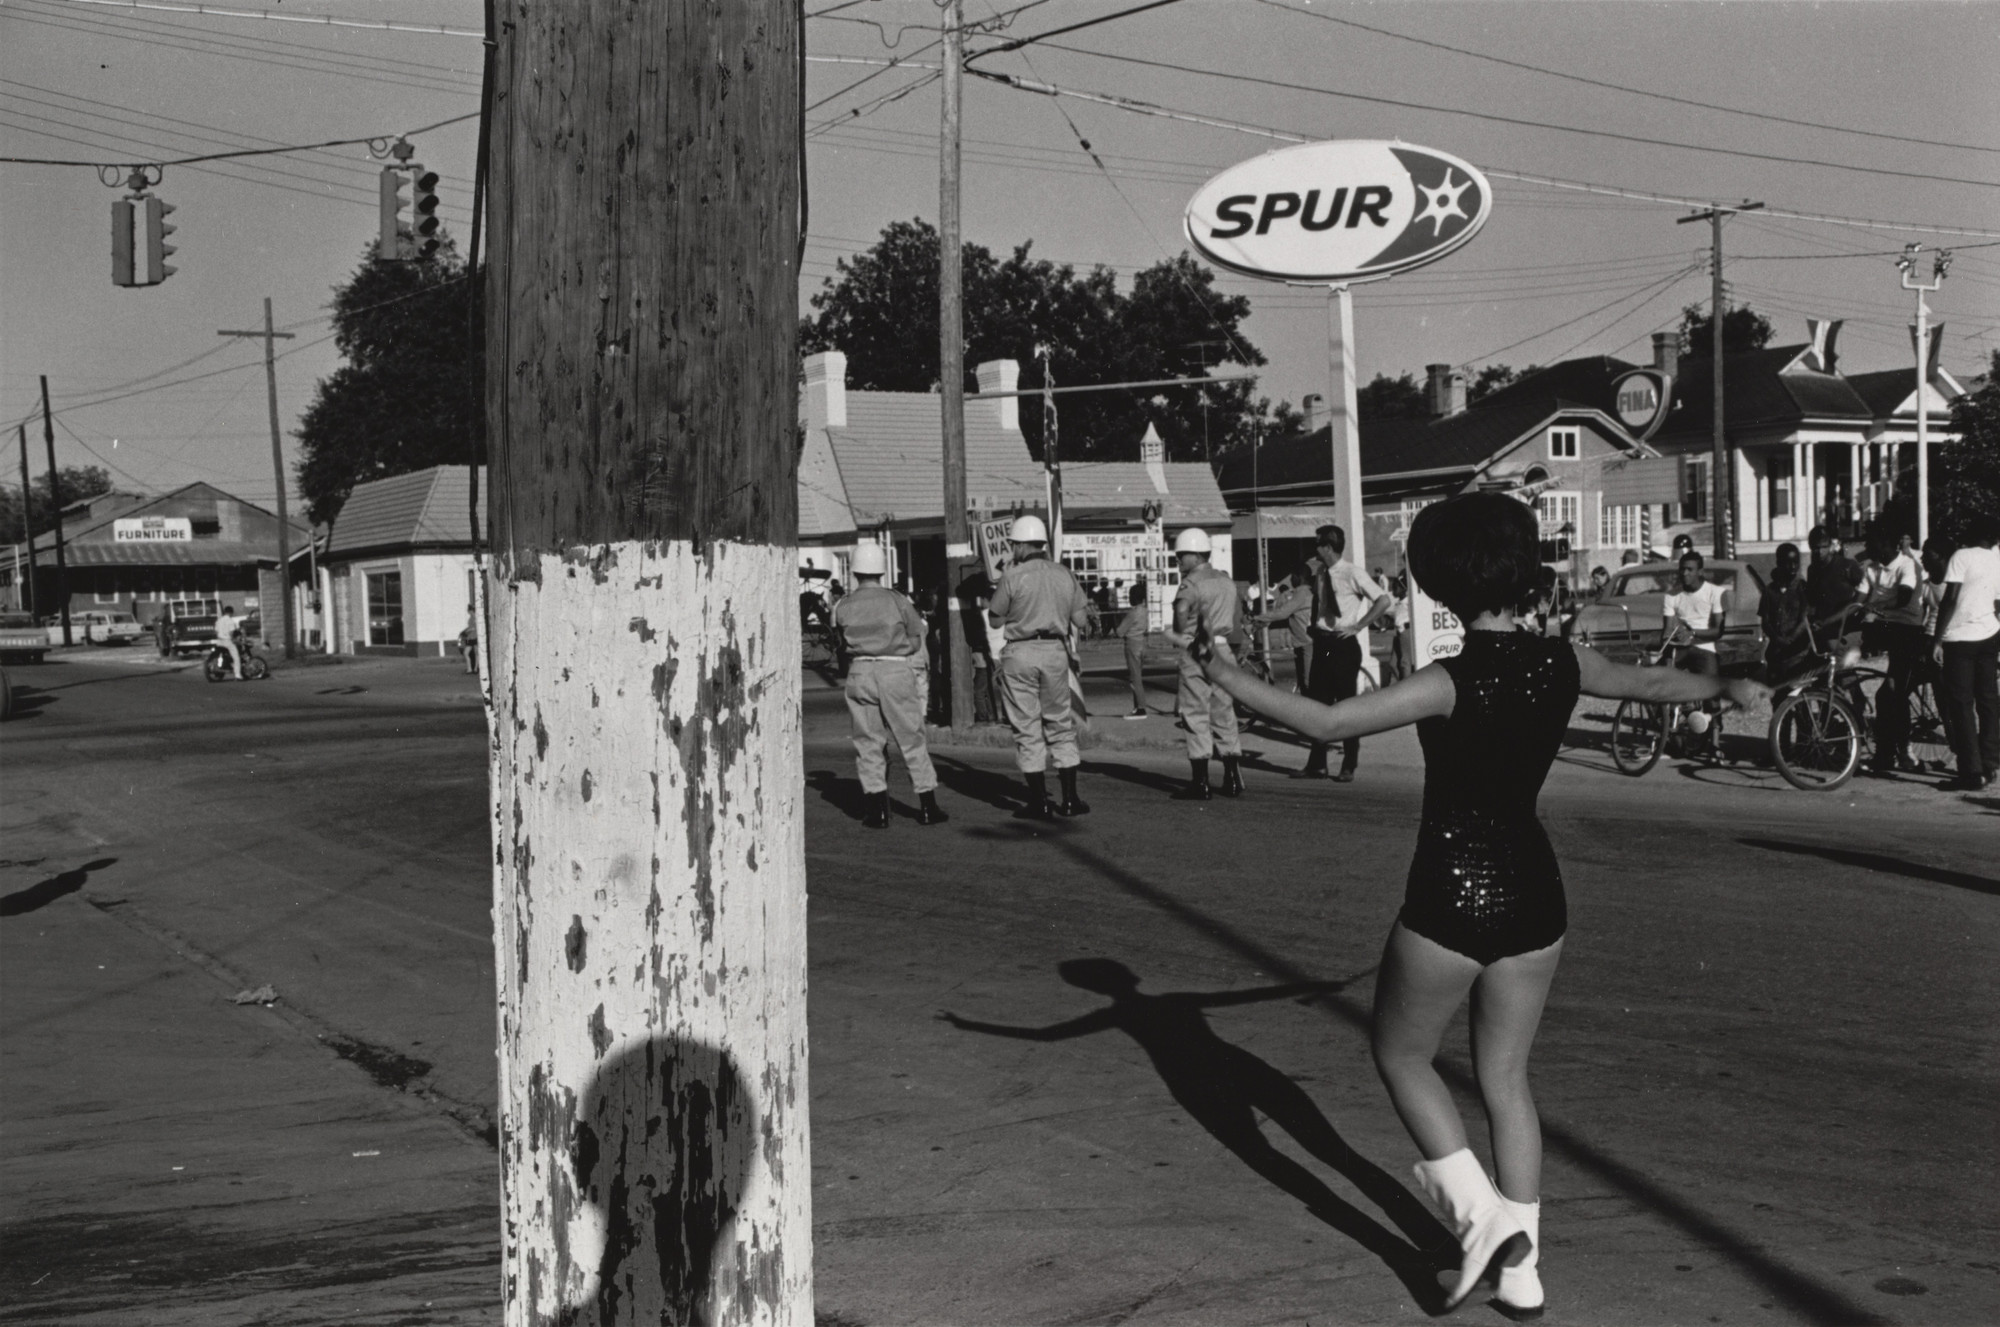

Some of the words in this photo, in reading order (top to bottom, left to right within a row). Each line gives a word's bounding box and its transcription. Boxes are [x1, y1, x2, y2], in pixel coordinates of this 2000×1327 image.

[1210, 185, 1393, 239] SPUR
[1619, 388, 1656, 413] FINA
[118, 529, 186, 539] FURNITURE
[985, 521, 1011, 540] ONE
[1431, 643, 1460, 656] SPUR
